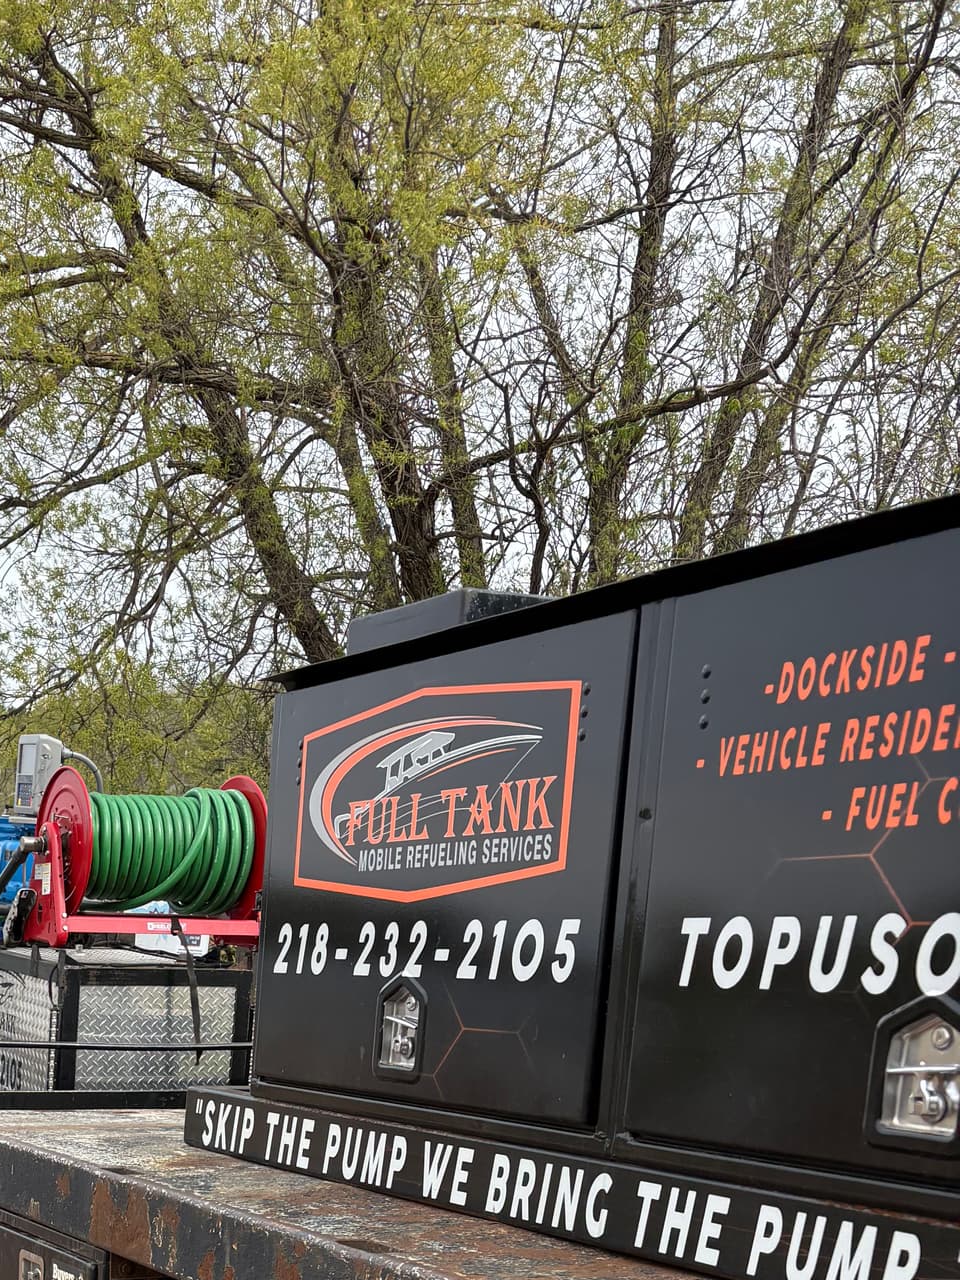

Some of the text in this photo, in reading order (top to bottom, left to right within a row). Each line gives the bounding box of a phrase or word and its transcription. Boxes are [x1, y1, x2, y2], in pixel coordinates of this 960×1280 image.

[717, 722, 832, 777] VEHICLE
[839, 703, 960, 763] RESIDE
[345, 776, 558, 846] FULL TANK
[845, 781, 920, 832] FUEL
[358, 833, 553, 872] MOBILE REFUELING SERVICES
[272, 918, 581, 984] 218-232-2105
[265, 1111, 315, 1169] THE
[322, 1123, 407, 1190] PUMP
[421, 1141, 476, 1205] WE
[484, 1155, 614, 1239] BRING
[634, 1181, 731, 1268] THE
